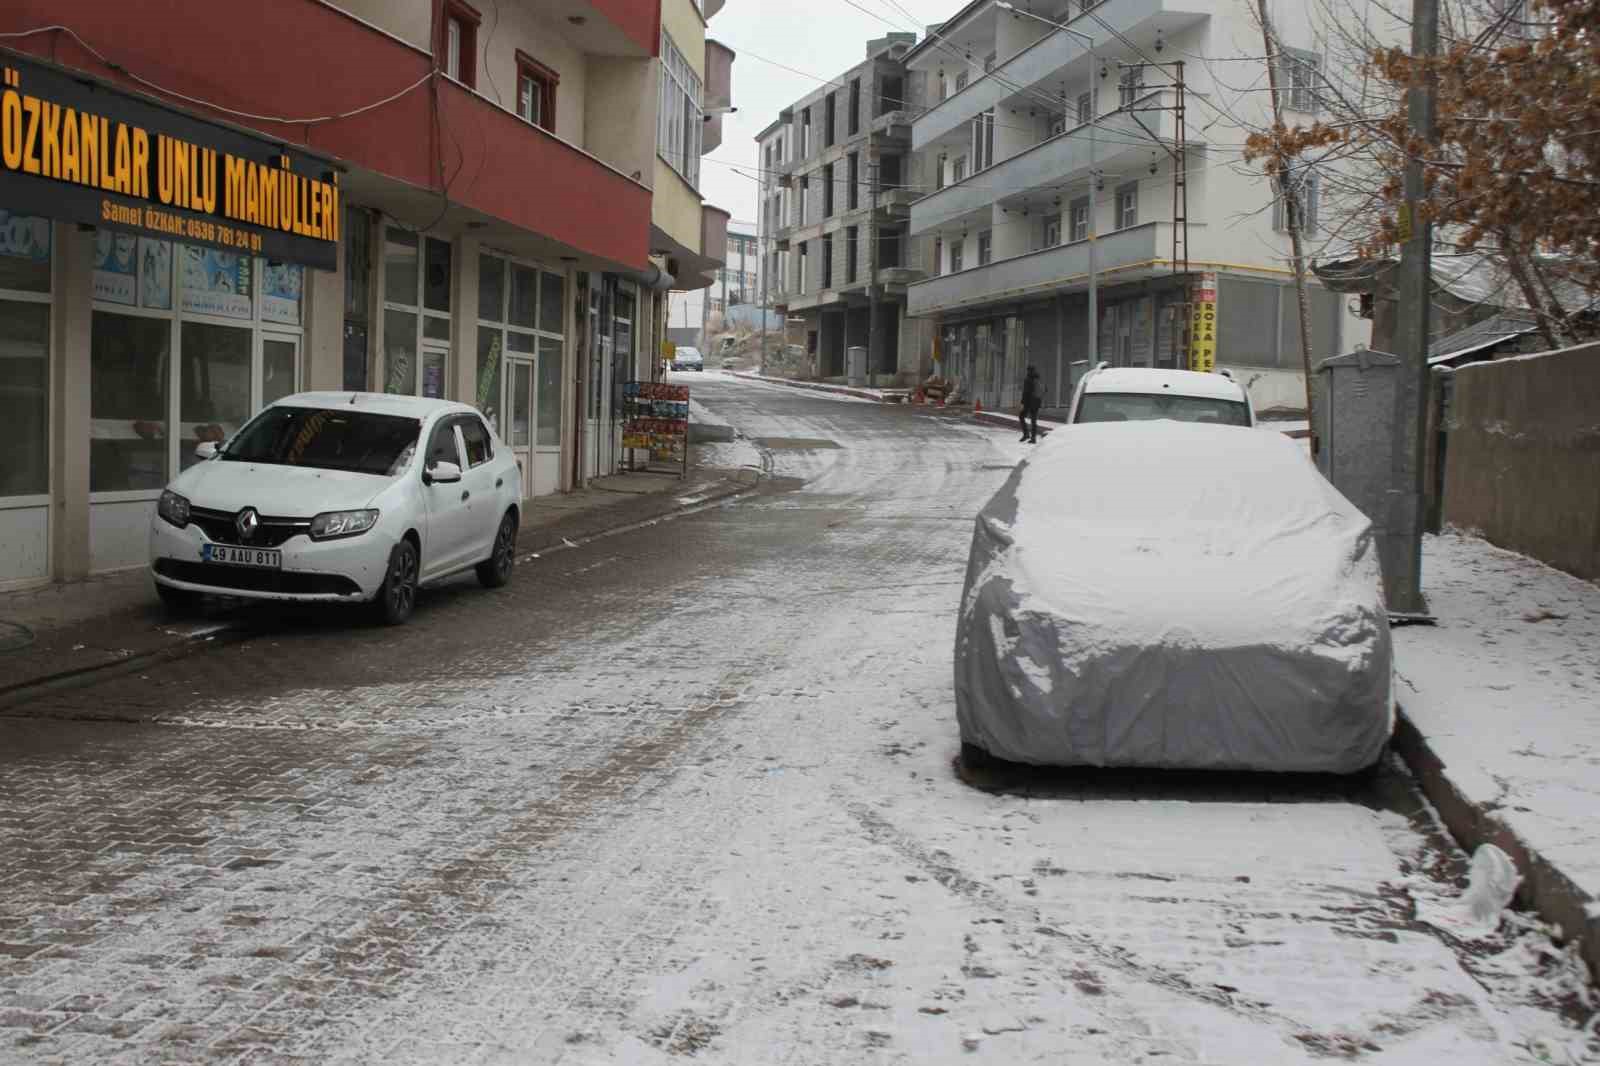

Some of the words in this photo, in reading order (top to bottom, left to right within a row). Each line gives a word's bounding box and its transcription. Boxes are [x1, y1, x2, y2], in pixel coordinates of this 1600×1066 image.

[2, 67, 149, 199] ÖZKANLAR
[158, 133, 216, 214] UNLU
[225, 155, 339, 241] MAMÜLLERİ
[102, 200, 142, 226] Samet
[187, 218, 215, 240] 0536
[1204, 303, 1214, 341] ROZA
[212, 545, 226, 561] 49
[231, 549, 252, 562] AAU
[256, 551, 277, 565] 811
